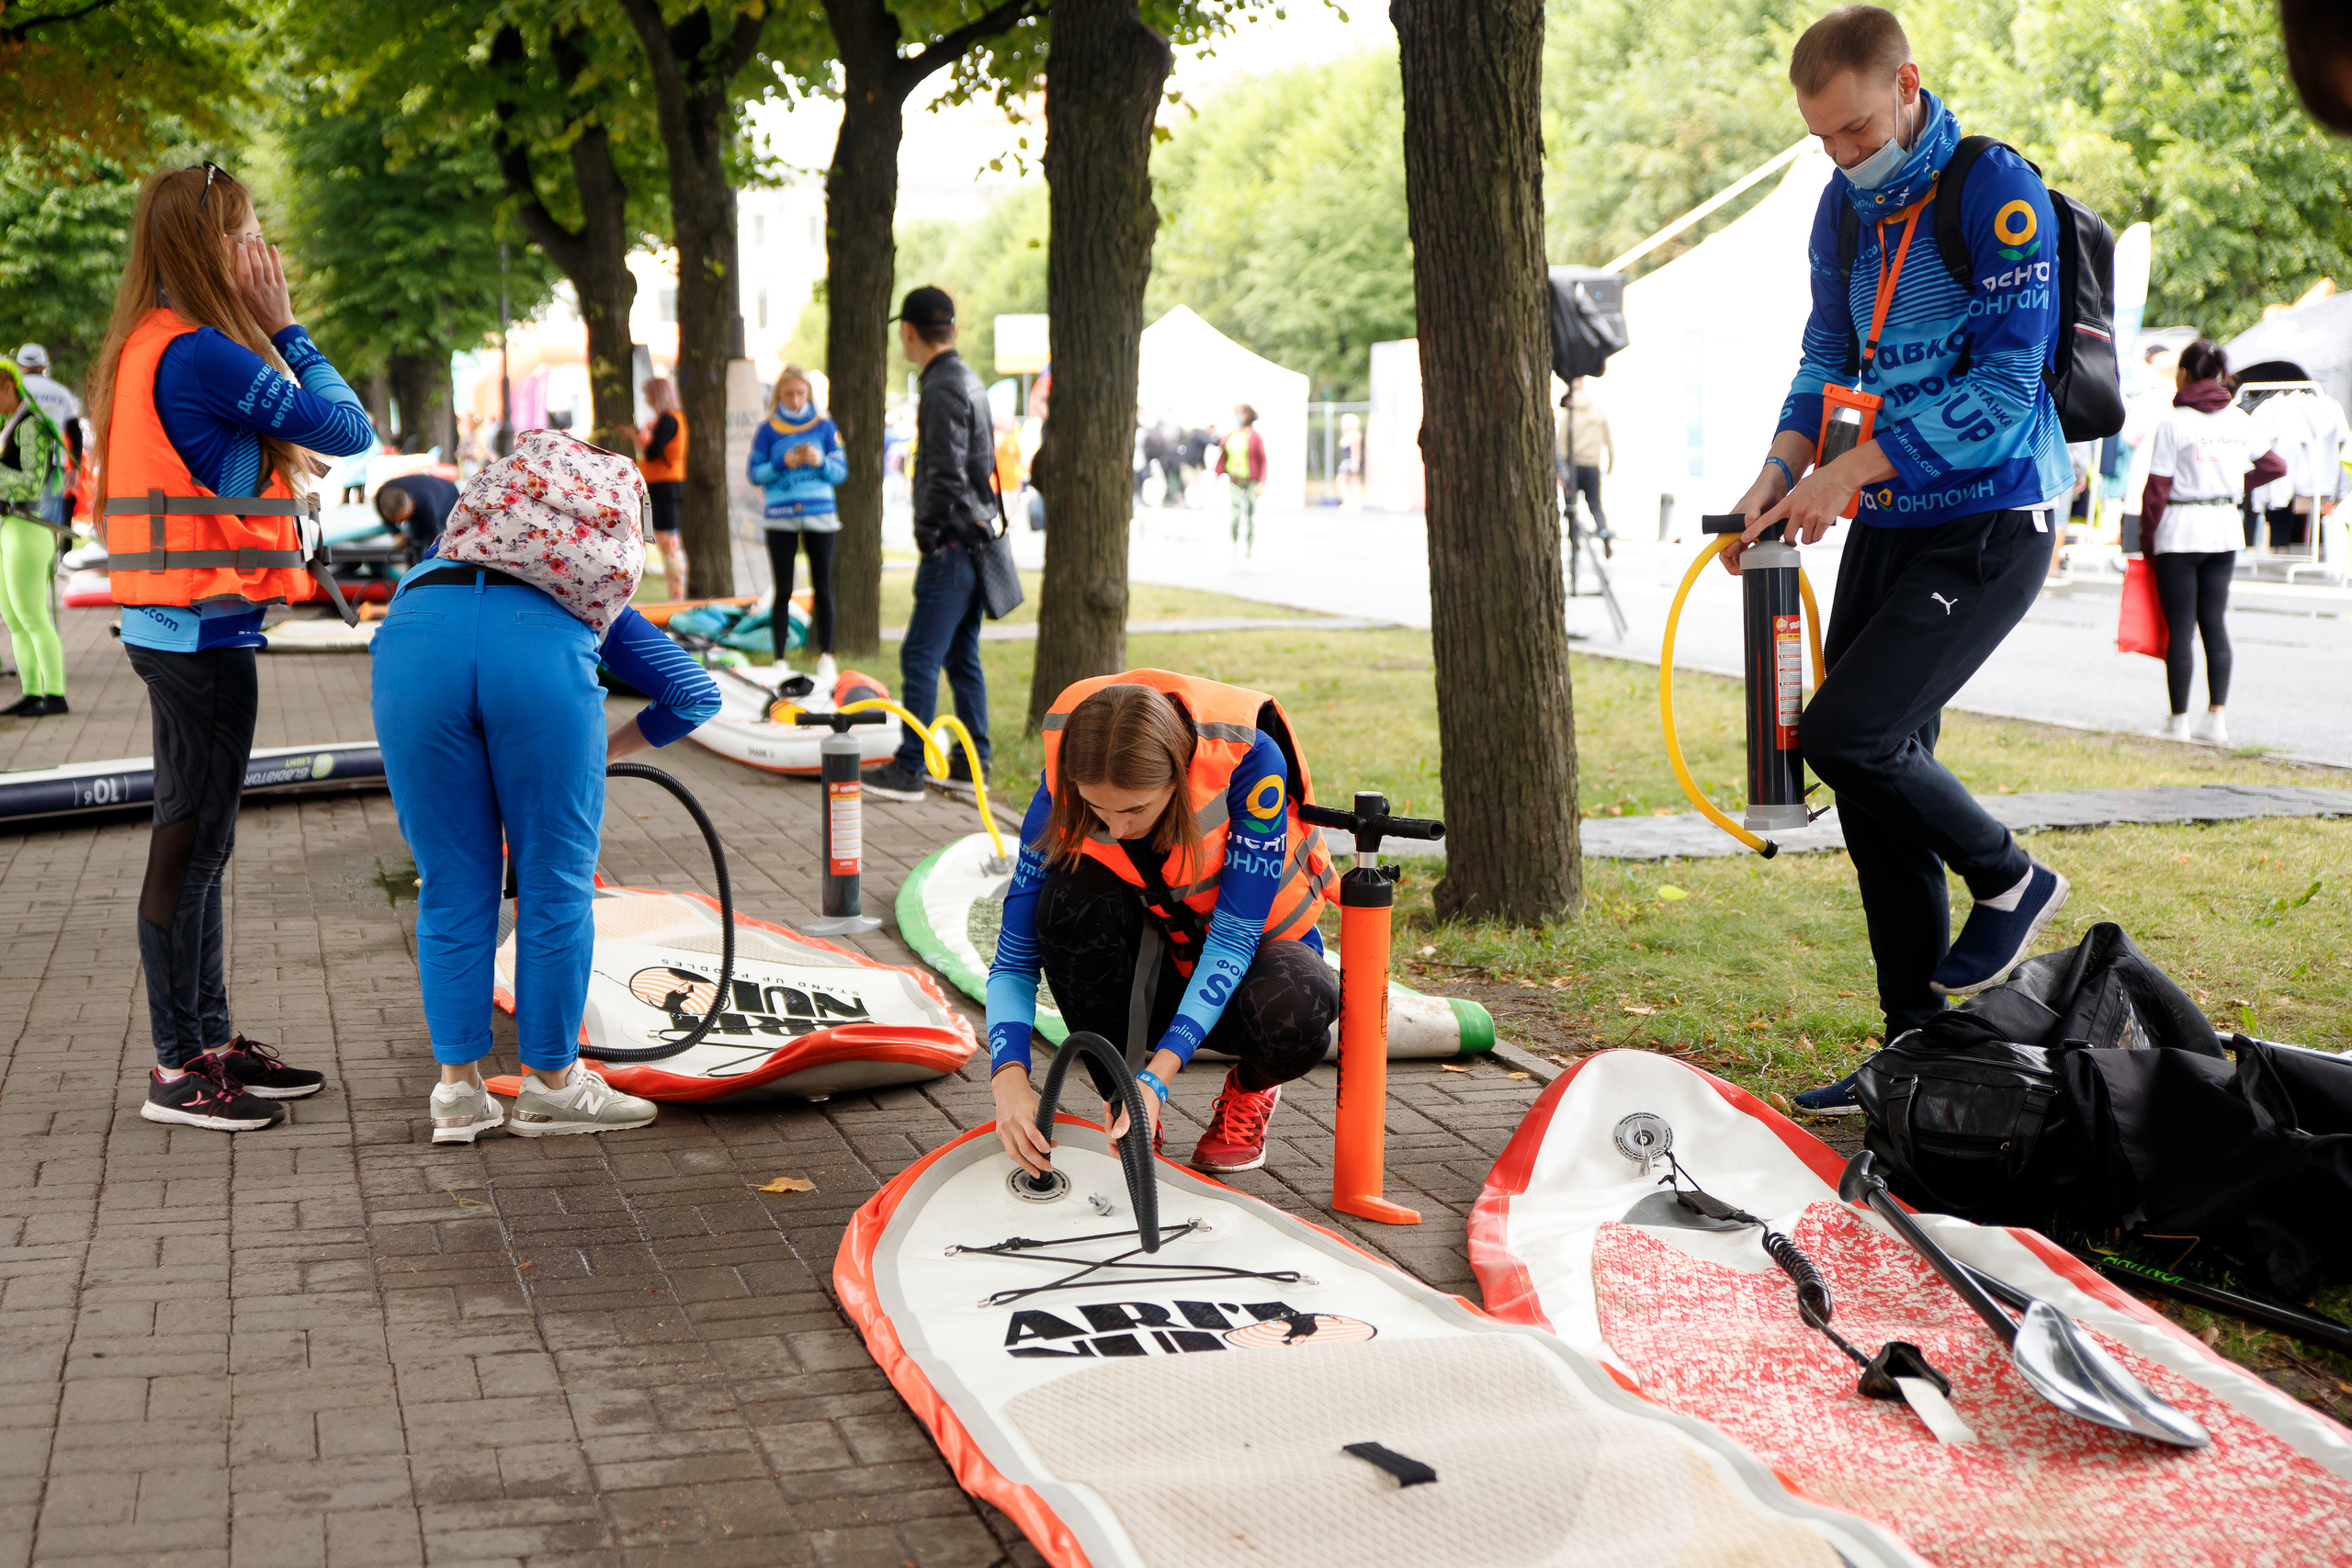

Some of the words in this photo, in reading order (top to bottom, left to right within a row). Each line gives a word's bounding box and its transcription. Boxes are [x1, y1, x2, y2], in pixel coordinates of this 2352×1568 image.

[1966, 378, 2013, 428] НТАНКА
[763, 975, 785, 986] UP
[797, 980, 860, 997] STAND
